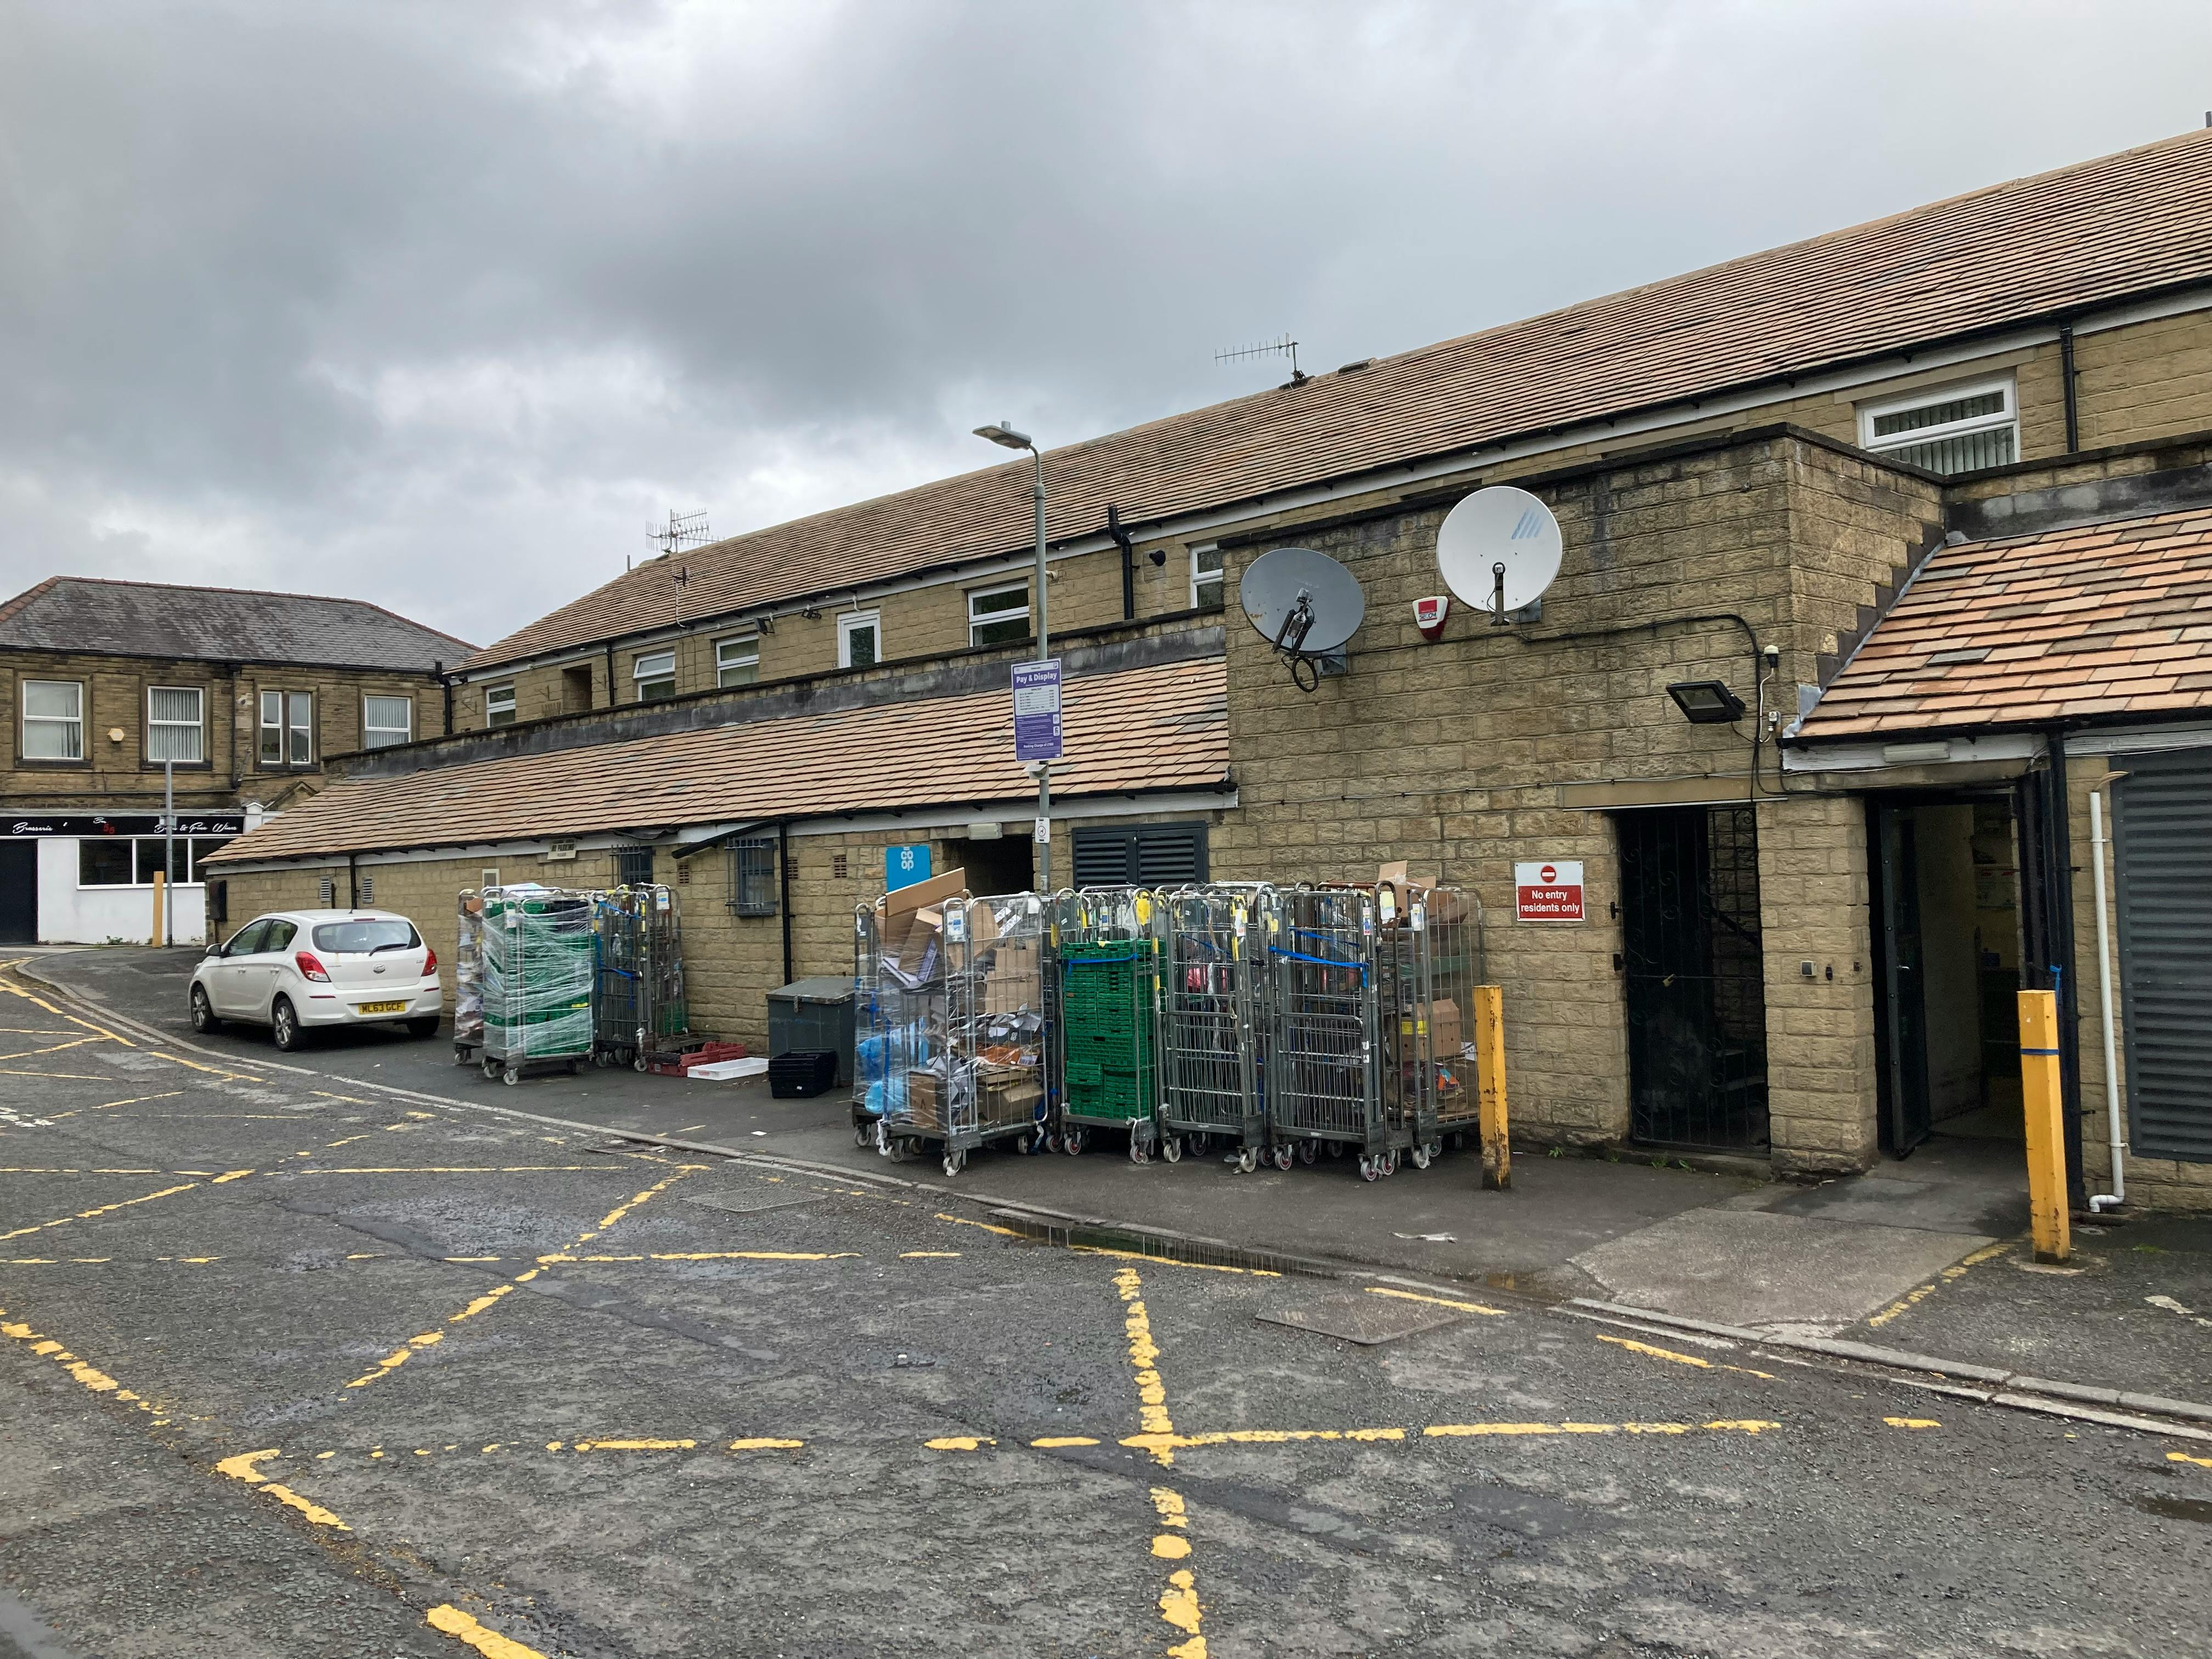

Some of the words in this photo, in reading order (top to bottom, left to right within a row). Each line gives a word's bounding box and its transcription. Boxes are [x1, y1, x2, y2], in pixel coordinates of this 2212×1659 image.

[1034, 672, 1057, 681] Display
[13, 822, 53, 834] Brasserie
[189, 822, 208, 833] Fine
[212, 822, 238, 833] Wines
[1531, 890, 1543, 899] No
[1545, 890, 1567, 901] entry
[1521, 903, 1559, 912] residents
[1561, 902, 1580, 913] only
[362, 1004, 384, 1013] ML63
[386, 1002, 402, 1011] GCF
